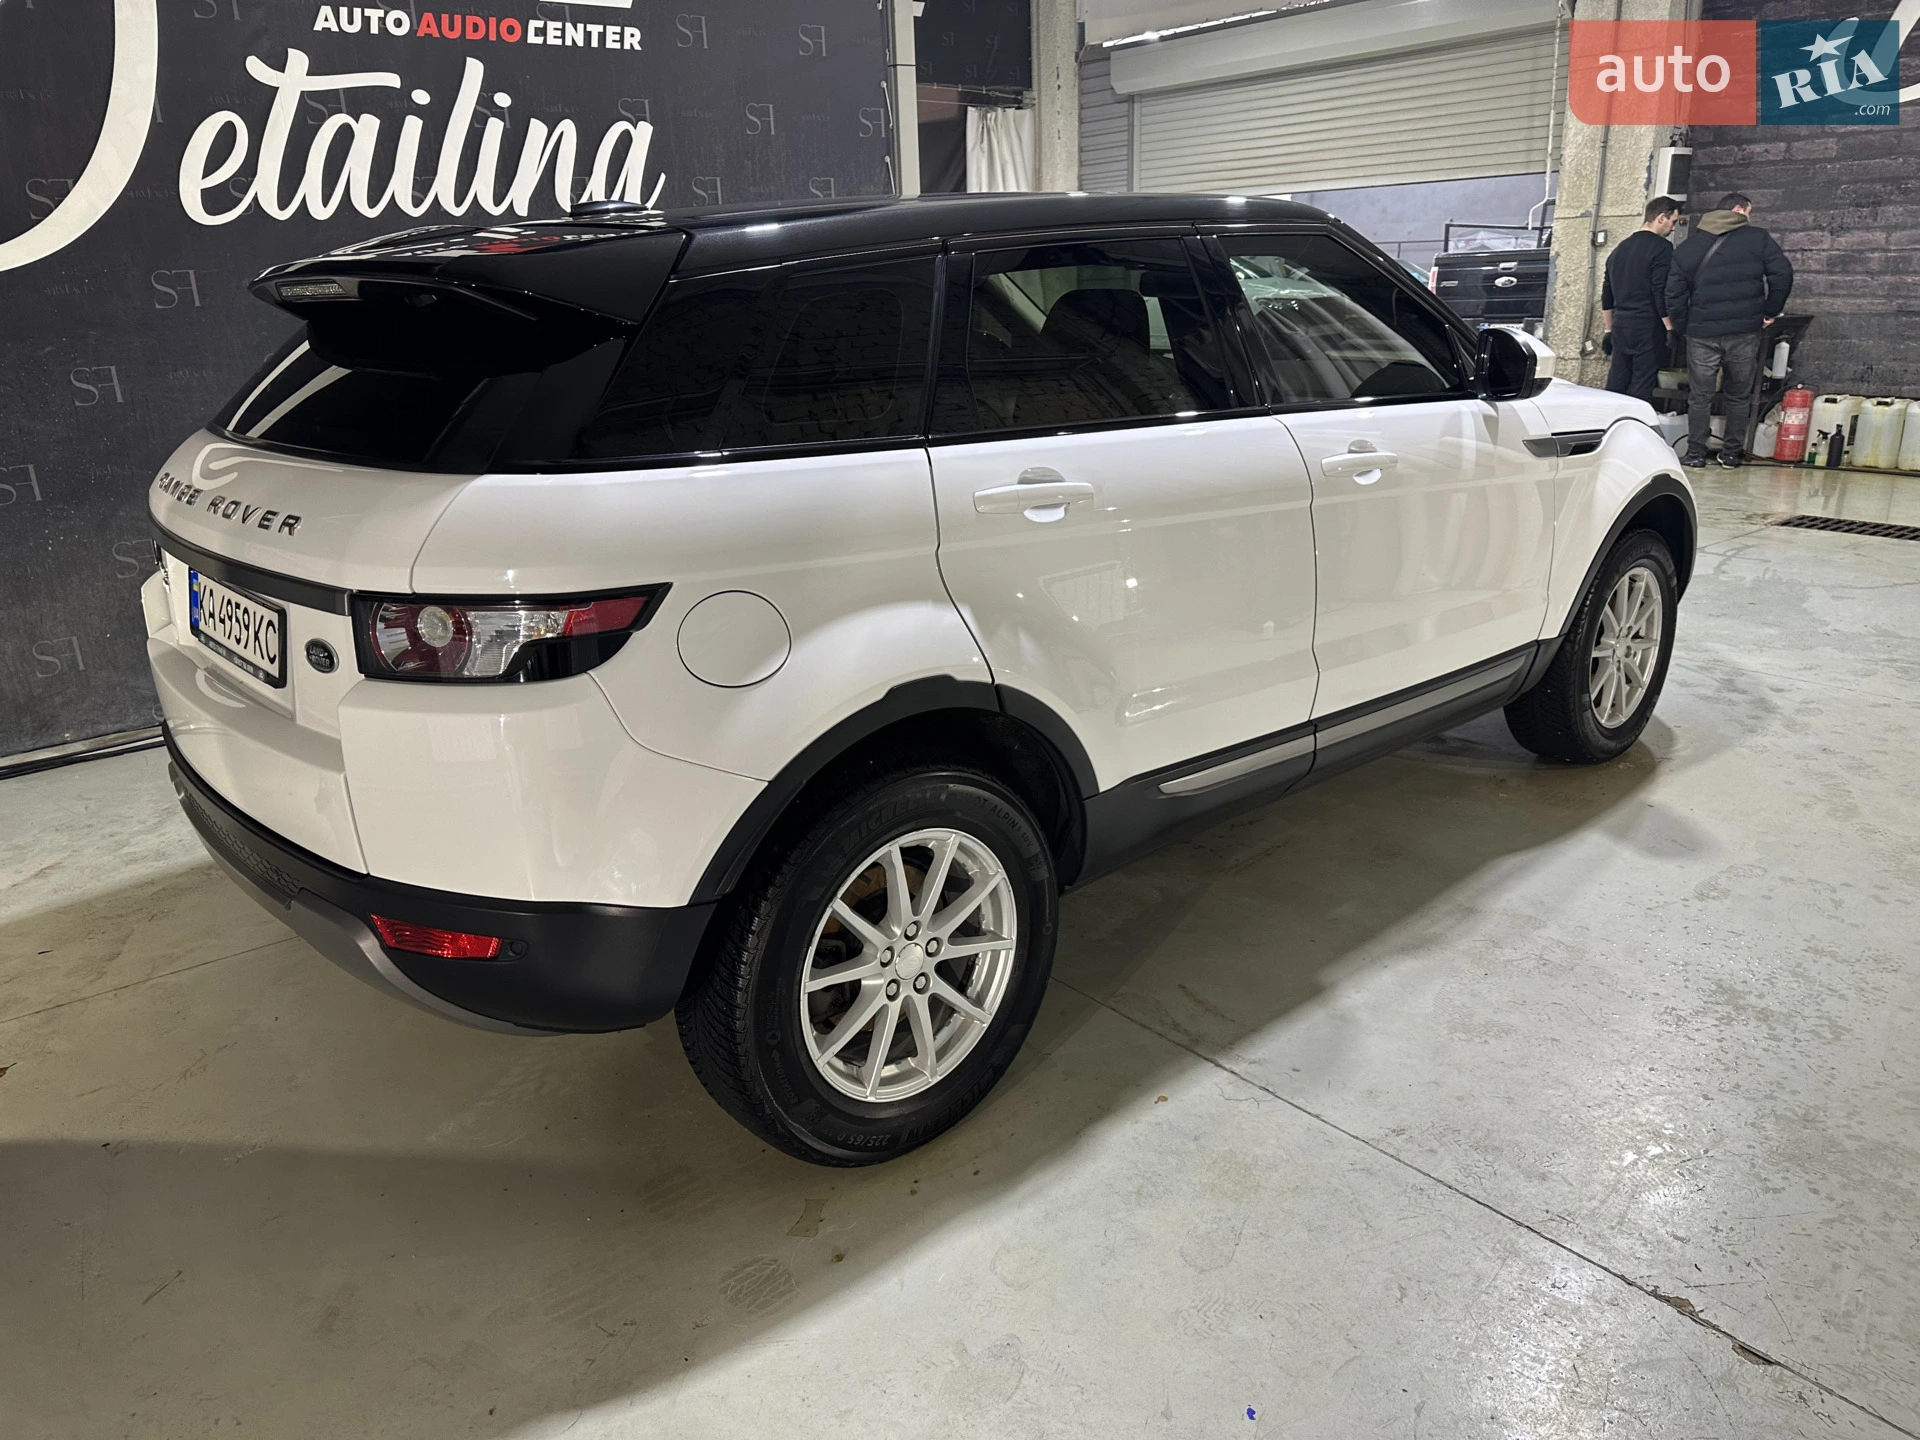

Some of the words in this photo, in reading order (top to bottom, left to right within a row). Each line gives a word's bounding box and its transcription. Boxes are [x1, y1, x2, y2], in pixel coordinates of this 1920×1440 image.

[313, 5, 410, 36] AUTO
[416, 12, 522, 42] AUDIO
[527, 19, 642, 51] CENTER
[158, 472, 204, 507] RANGE
[206, 495, 303, 537] ROVER
[308, 645, 325, 657] LAND
[311, 656, 331, 668] ROVER
